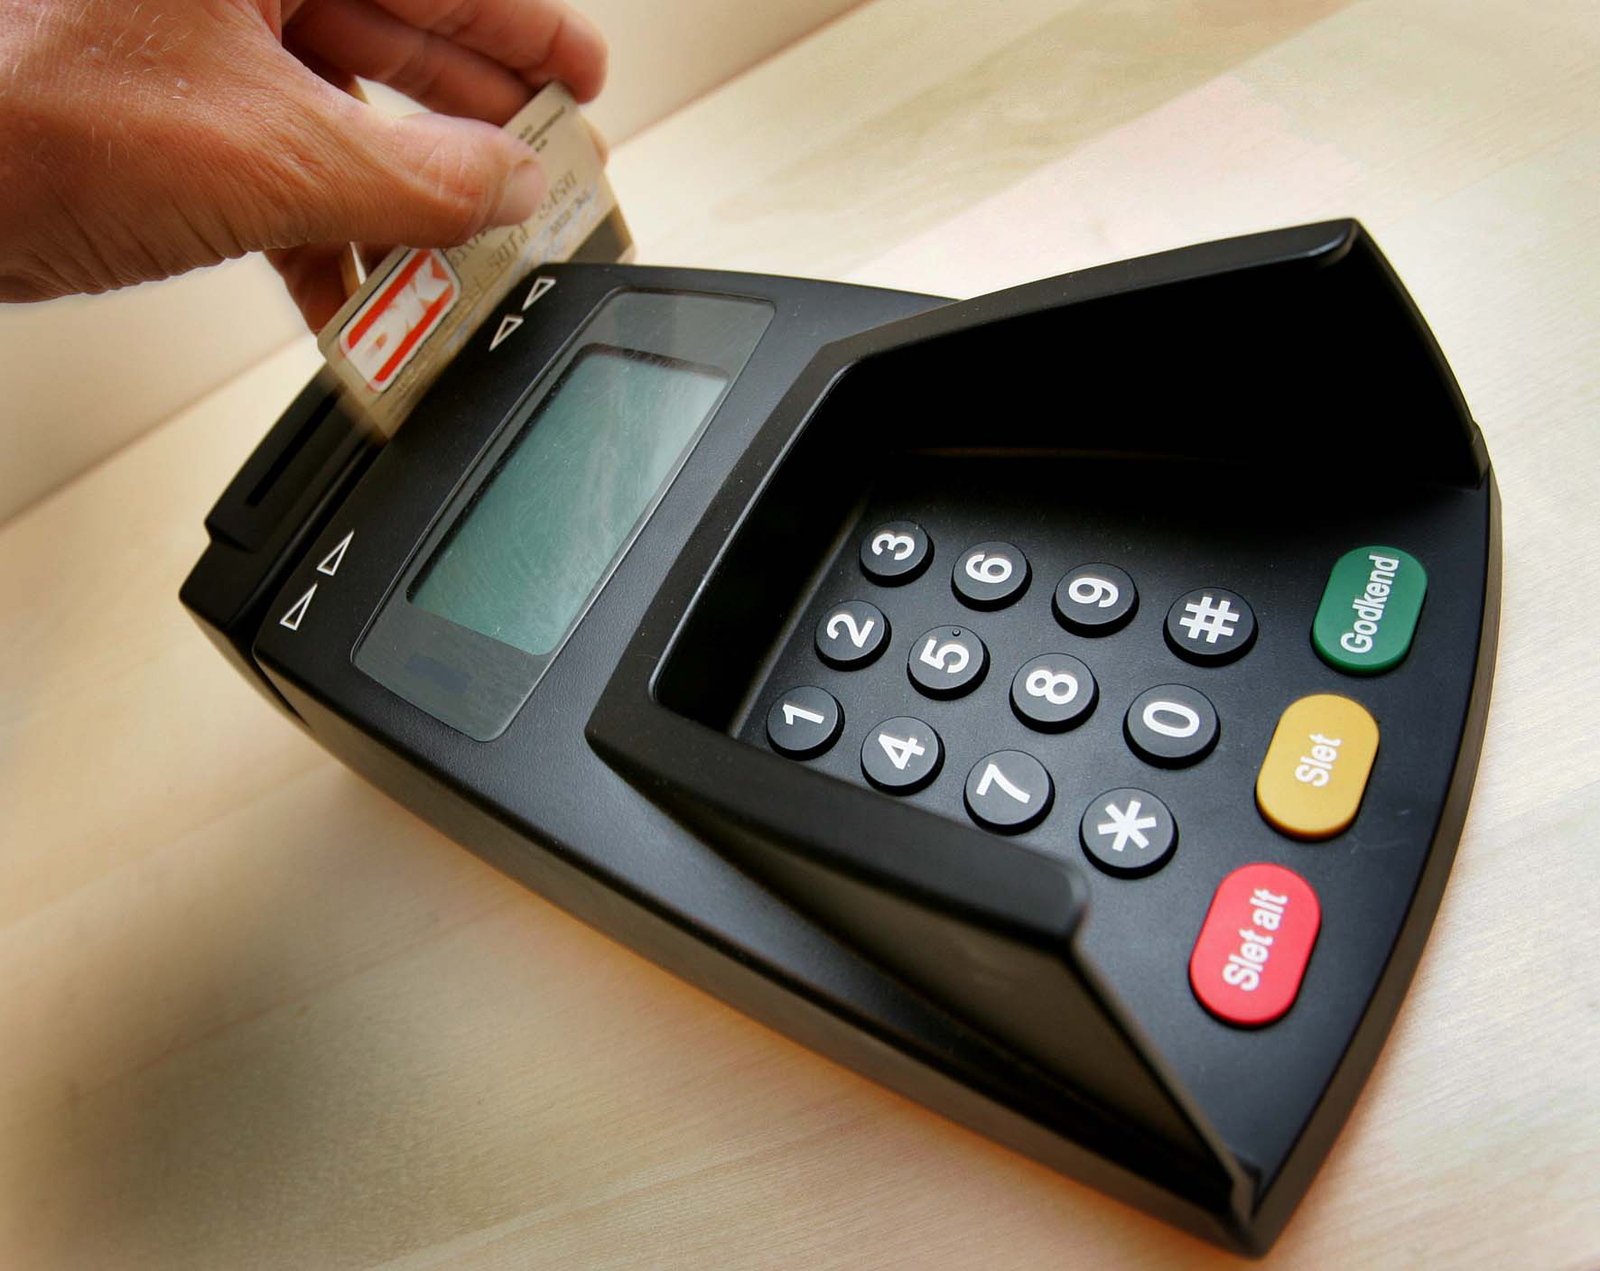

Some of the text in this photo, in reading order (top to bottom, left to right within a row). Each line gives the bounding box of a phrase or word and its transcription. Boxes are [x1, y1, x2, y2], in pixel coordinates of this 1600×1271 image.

[870, 531, 916, 561] 3
[964, 553, 1013, 585] 6
[1067, 576, 1120, 609] 9
[1340, 554, 1400, 655] Godkend
[826, 613, 876, 649] 2
[1178, 596, 1240, 644] #
[919, 640, 970, 674] 5
[1024, 666, 1079, 706] 8
[782, 702, 826, 727] 1
[1142, 700, 1200, 739] 0
[877, 729, 926, 770] 4
[1294, 732, 1344, 789] Slet
[975, 762, 1032, 806] 7
[1221, 888, 1289, 992] Slet alt
